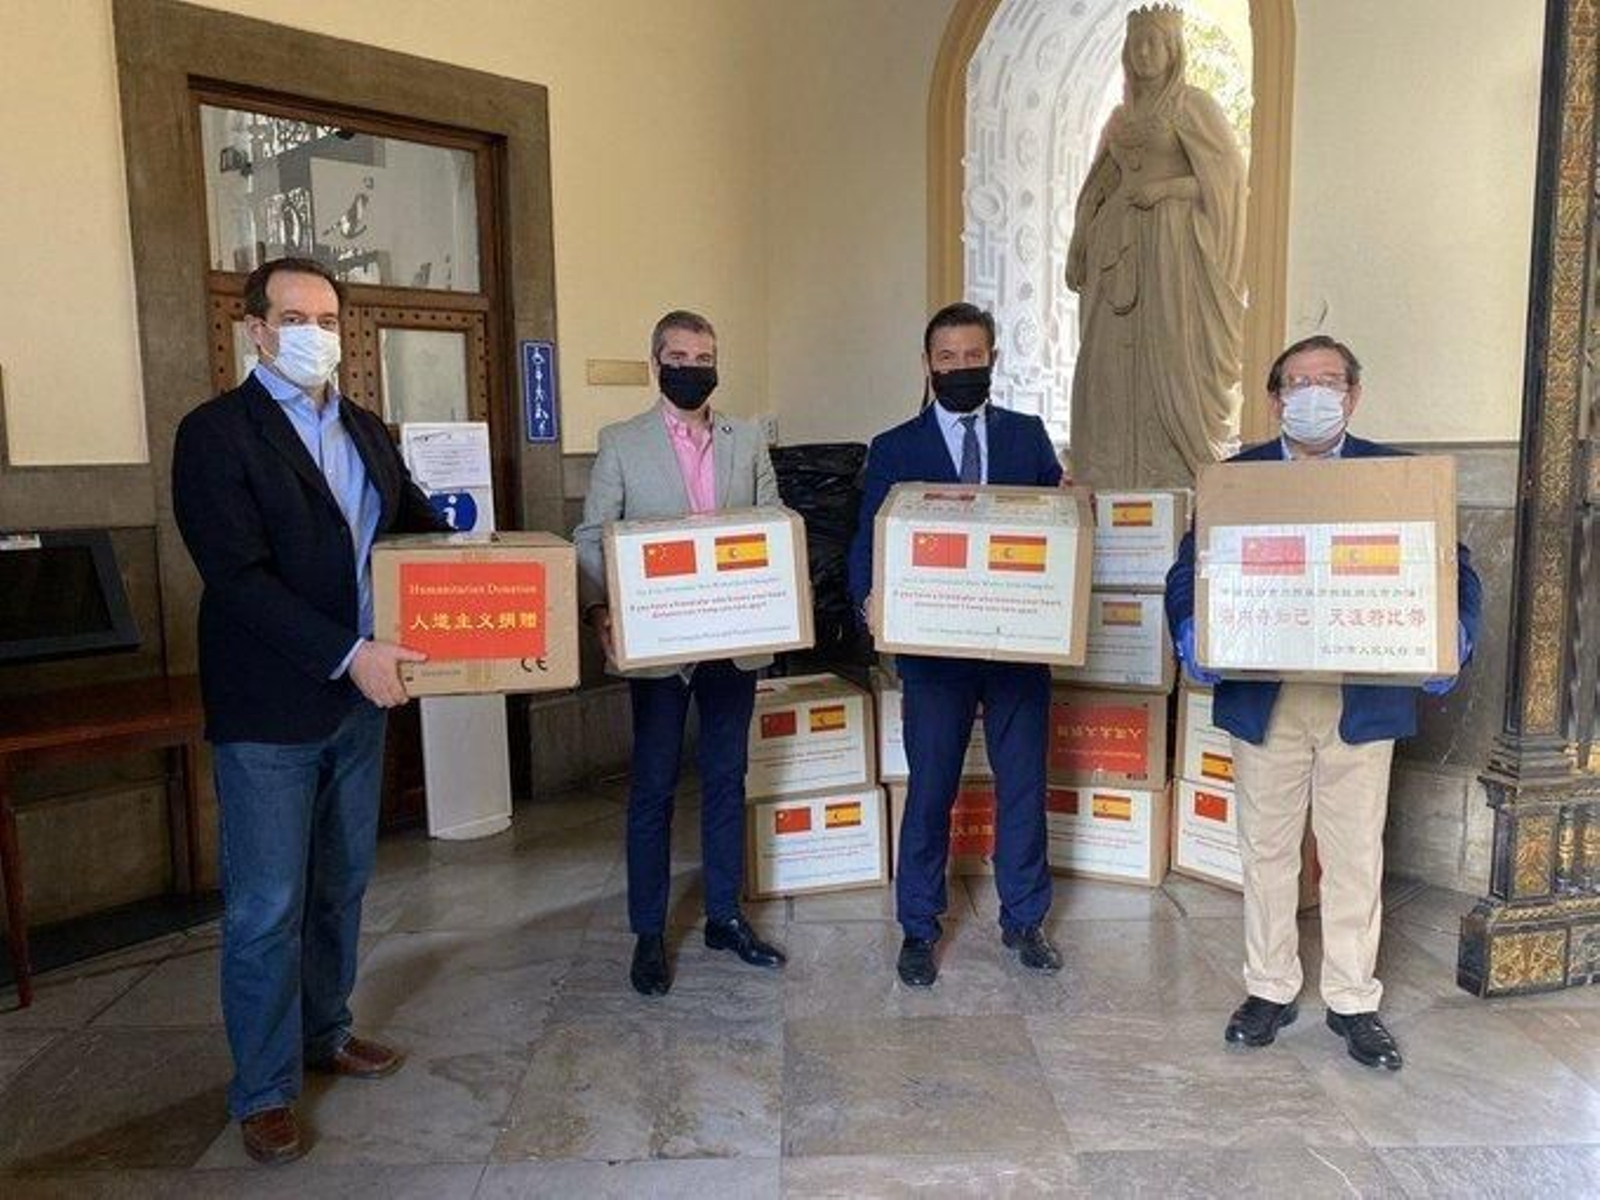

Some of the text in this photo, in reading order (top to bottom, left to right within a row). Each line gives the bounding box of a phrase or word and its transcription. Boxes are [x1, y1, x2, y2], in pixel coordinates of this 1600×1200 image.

[409, 584, 537, 596] Humanitarian Donation
[410, 611, 537, 630] 人道主义捐赠
